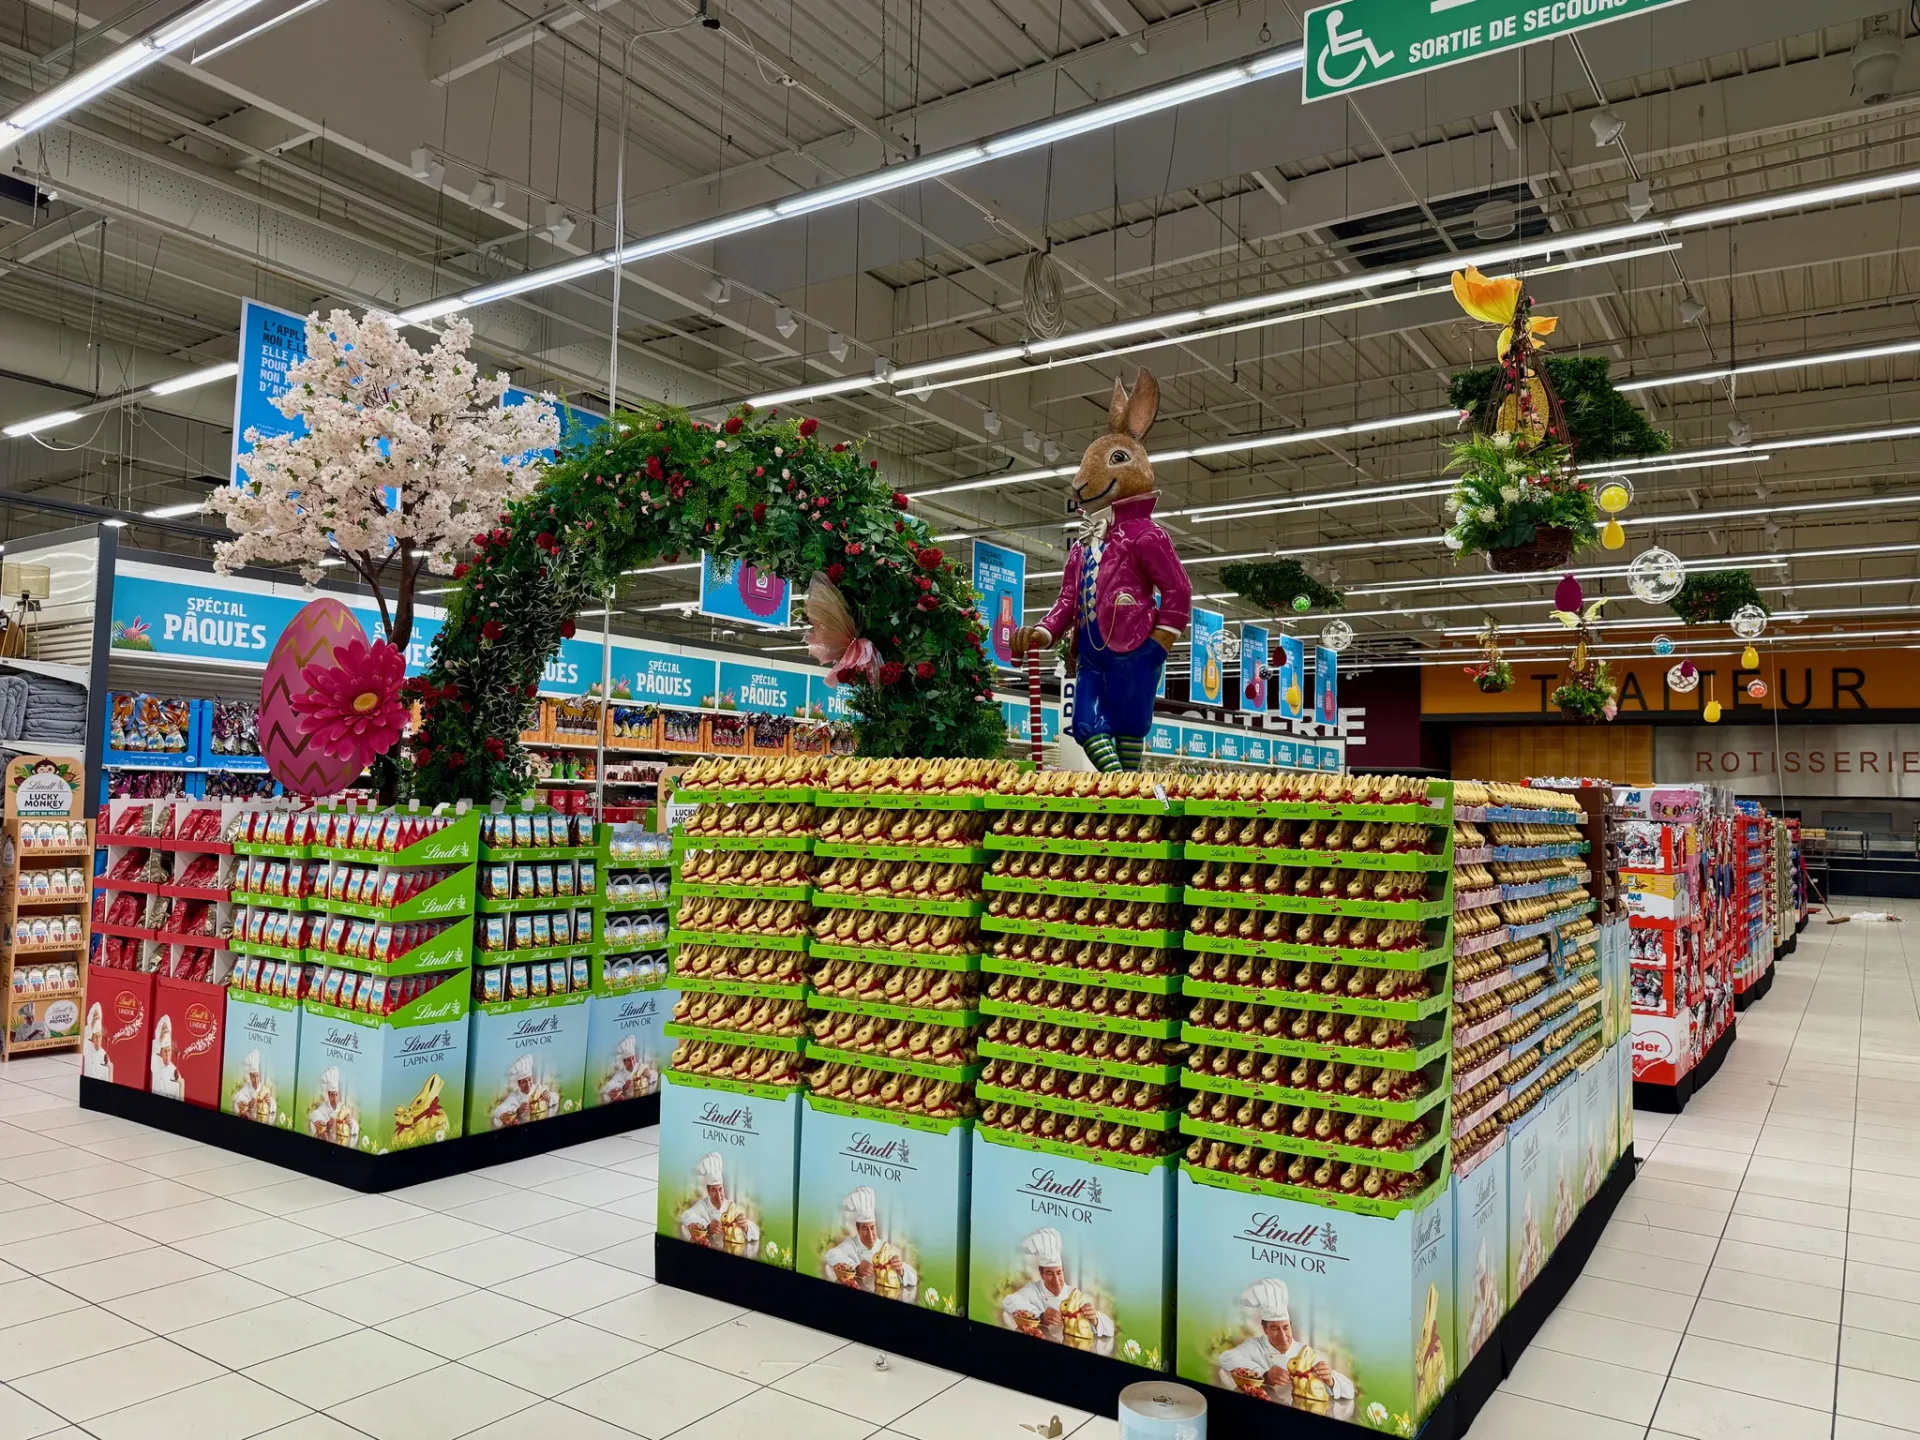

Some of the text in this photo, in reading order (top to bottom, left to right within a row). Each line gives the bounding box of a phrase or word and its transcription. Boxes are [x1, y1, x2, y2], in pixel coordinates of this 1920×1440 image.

[1409, 25, 1481, 63] SORTIE
[1489, 14, 1517, 39] DE
[262, 332, 282, 348] MON
[262, 345, 288, 362] ELLE
[260, 369, 280, 384] MON
[187, 596, 247, 618] SPÉCIAL
[163, 611, 266, 650] PÂQUES
[649, 660, 681, 674] SPÉCIAL
[636, 671, 692, 697] PÂQUES
[752, 674, 778, 686] SPÉCIAL
[740, 684, 787, 707] PÂQUES
[1530, 667, 1870, 712] TAITEUR
[1696, 751, 1920, 774] ROTISSERIE
[25, 800, 64, 809] MONKEY
[421, 843, 460, 859] Lindt
[418, 897, 456, 914] Lindt
[416, 950, 454, 968] Lindt
[412, 1004, 451, 1020] Lindt
[618, 1000, 648, 1018] Lindt
[247, 1012, 270, 1030] Lindt
[513, 1018, 550, 1036] Lindt
[621, 1019, 639, 1030] LAPIN
[248, 1032, 272, 1045] LAPIN OR
[324, 1028, 352, 1048] Lindt
[401, 1035, 441, 1053] Lindt
[515, 1036, 552, 1048] LAPIN OR
[326, 1048, 354, 1063] LAPIN OR
[403, 1053, 444, 1067] LAPIN OR
[699, 1102, 742, 1126] Lindt
[703, 1129, 745, 1147] LAPIN OR
[846, 1132, 897, 1159] Lindt
[851, 1160, 901, 1182] LAPIN OR
[1026, 1167, 1087, 1199] Lindt
[1031, 1199, 1093, 1224] LAPIN OR
[1244, 1212, 1319, 1247] Lindt
[1252, 1245, 1327, 1274] LAPIN OR
